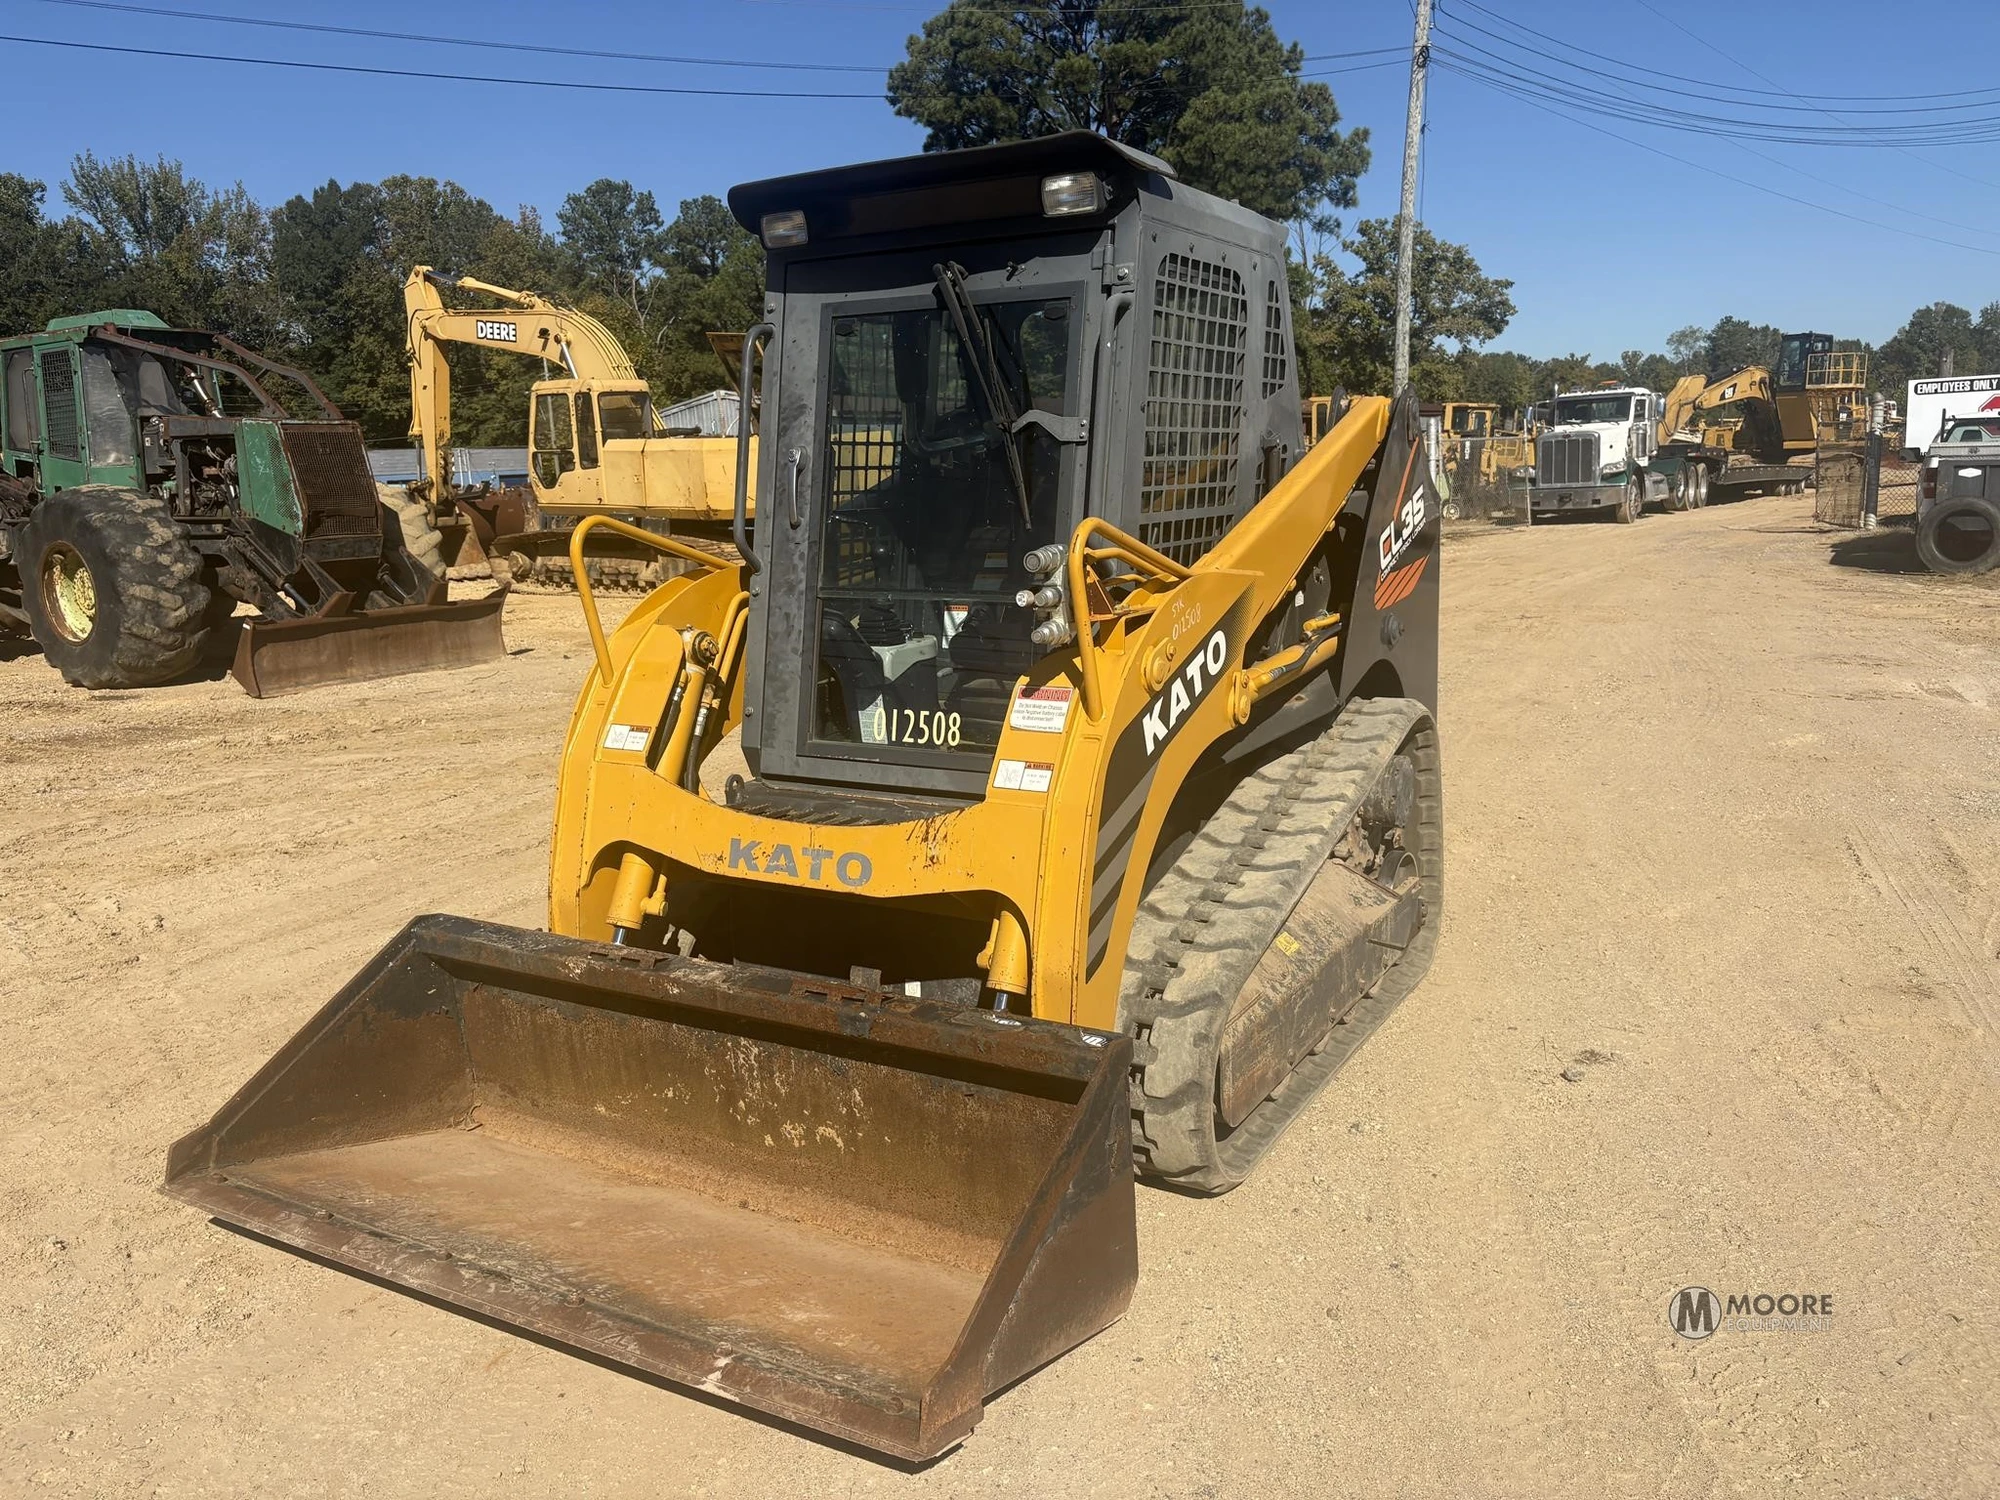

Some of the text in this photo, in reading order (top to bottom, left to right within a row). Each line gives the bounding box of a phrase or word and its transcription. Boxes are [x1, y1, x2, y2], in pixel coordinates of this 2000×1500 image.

[477, 320, 517, 341] DEERE
[1917, 379, 1999, 394] EMPLOYEES ONLY
[1142, 630, 1227, 756] KATO
[873, 707, 961, 747] 012508
[728, 838, 873, 887] KATO
